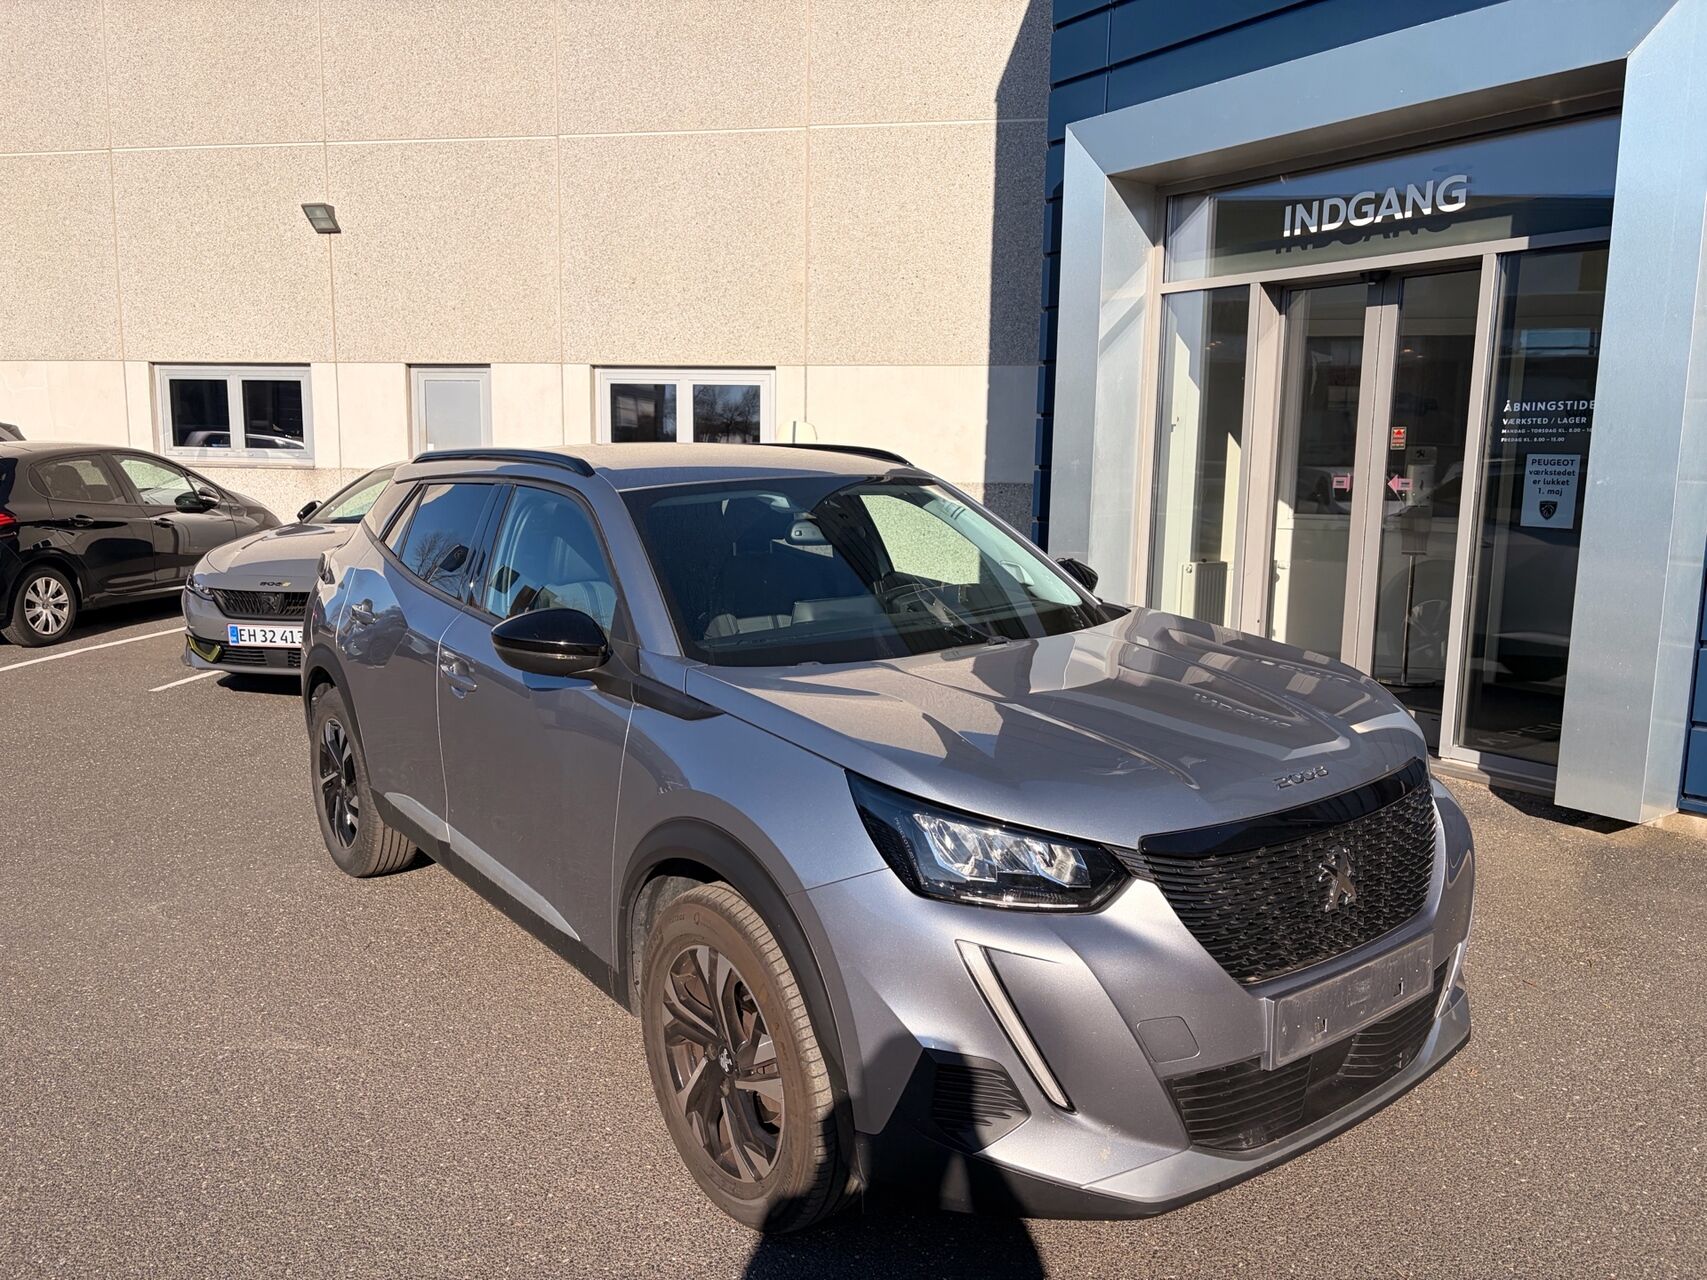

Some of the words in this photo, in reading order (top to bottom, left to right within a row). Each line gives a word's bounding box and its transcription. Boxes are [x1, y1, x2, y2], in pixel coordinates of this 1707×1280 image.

[1282, 174, 1468, 238] INDGANG
[1502, 417, 1549, 425] VÆRKSTED
[1557, 416, 1587, 424] LAGER
[1531, 458, 1576, 467] PEUGEOT
[1528, 468, 1576, 476] værkstedet
[1543, 478, 1570, 486] lukket
[1538, 487, 1545, 495] 1.
[1546, 488, 1563, 497] maj
[238, 628, 257, 642] EH
[259, 629, 277, 643] 32
[1273, 765, 1329, 790] 2008
